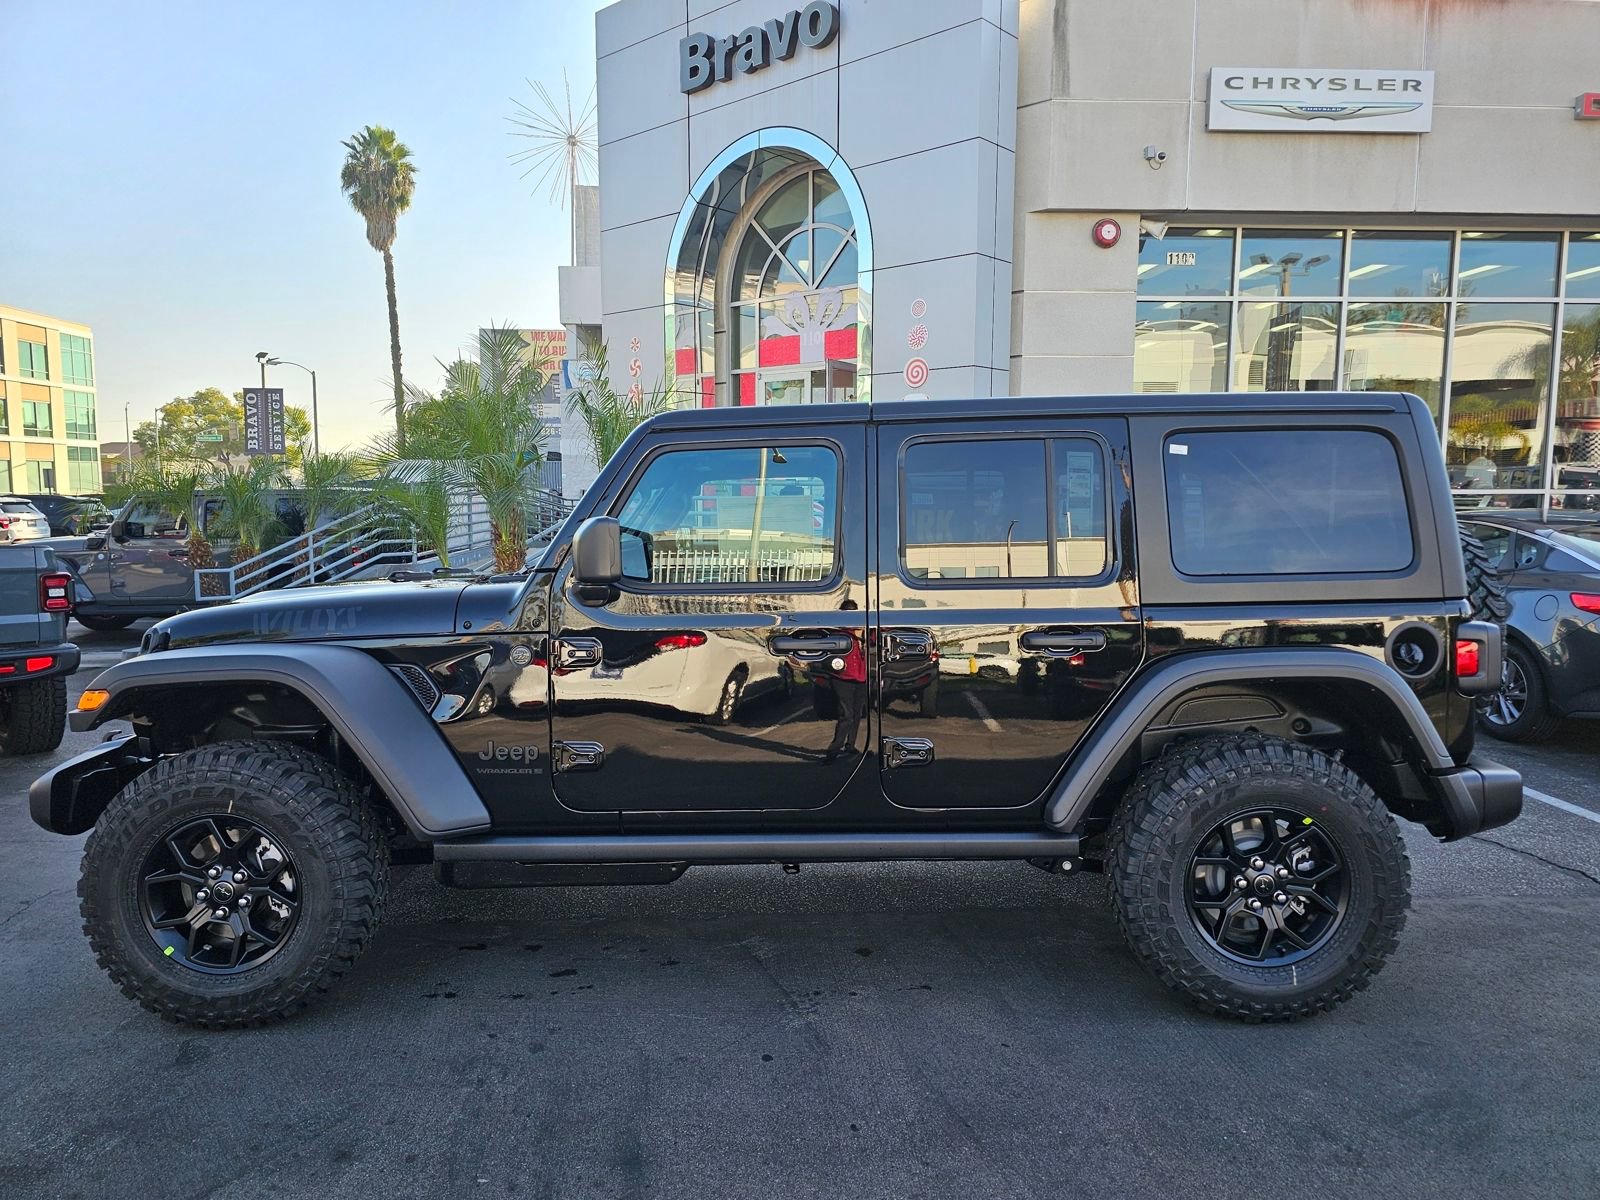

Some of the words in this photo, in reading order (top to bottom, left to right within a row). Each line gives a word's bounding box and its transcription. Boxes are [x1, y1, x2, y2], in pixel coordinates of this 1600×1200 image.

[679, 0, 840, 94] Bravo
[1224, 76, 1423, 92] CHRYSLER
[246, 393, 259, 450] BRAVO
[272, 393, 282, 450] SERVICE
[478, 741, 539, 765] Jeep
